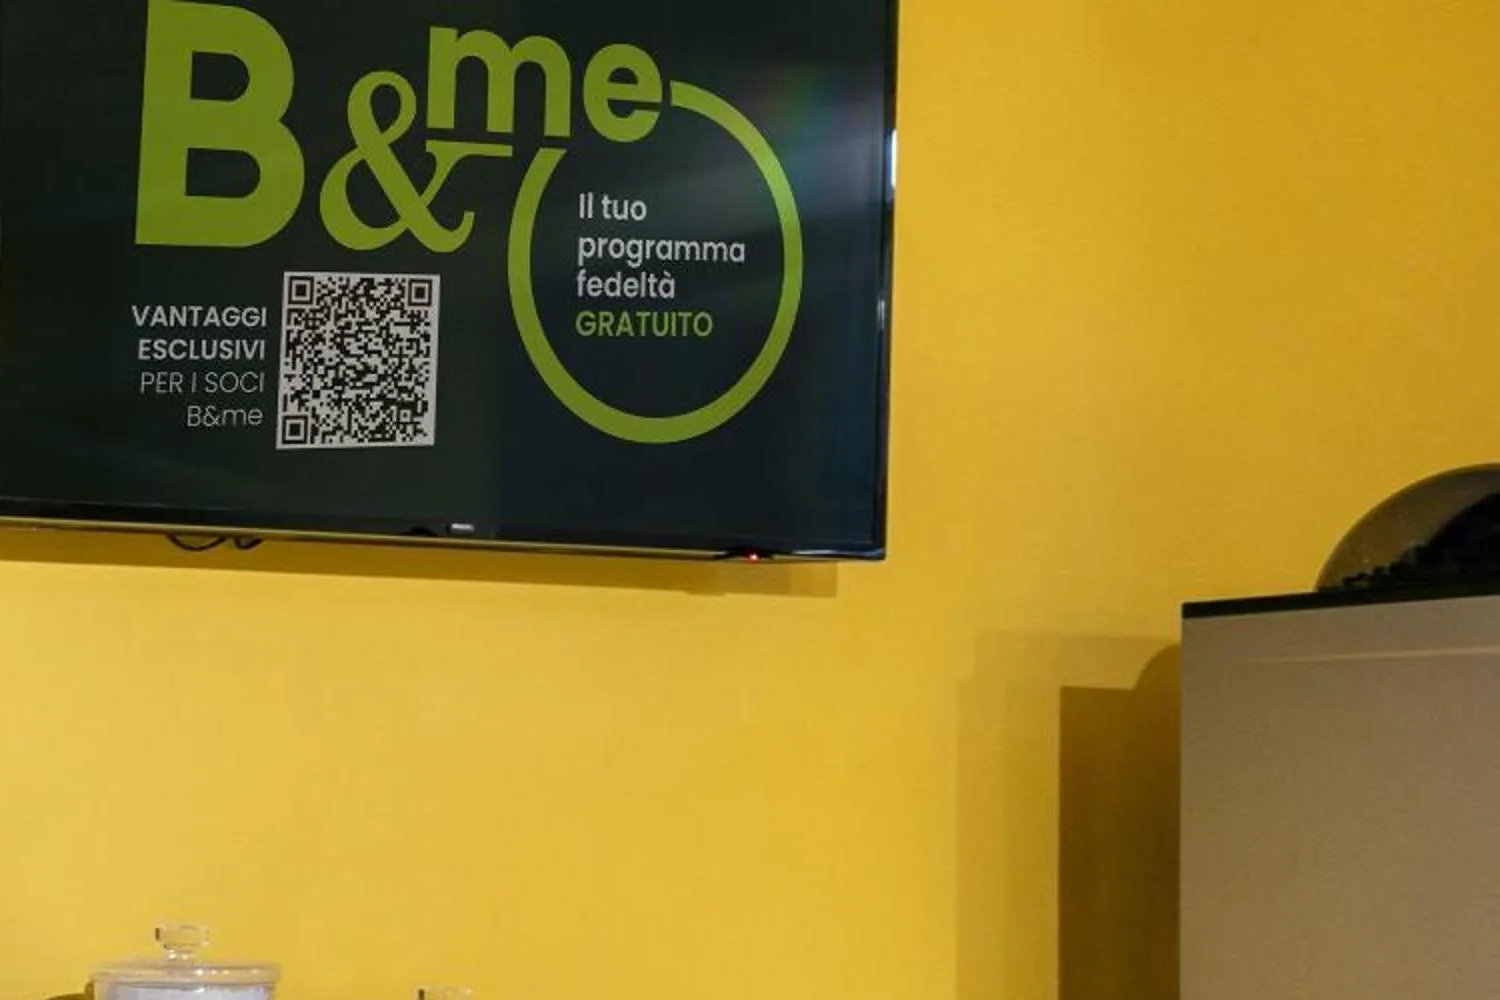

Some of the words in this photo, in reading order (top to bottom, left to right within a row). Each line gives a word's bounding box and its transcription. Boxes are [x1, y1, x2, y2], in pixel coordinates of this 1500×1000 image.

[579, 192, 594, 219] Il
[601, 195, 647, 221] tuo
[578, 237, 746, 268] programma
[577, 269, 676, 299] fedeltà
[131, 305, 268, 328] VANTAGGI
[575, 311, 713, 338] GRATUITO
[137, 339, 266, 361] ESCLUSIVI
[140, 371, 183, 393] PER
[191, 373, 197, 393] I
[205, 371, 265, 393] SOCI
[187, 405, 263, 427] B&me
